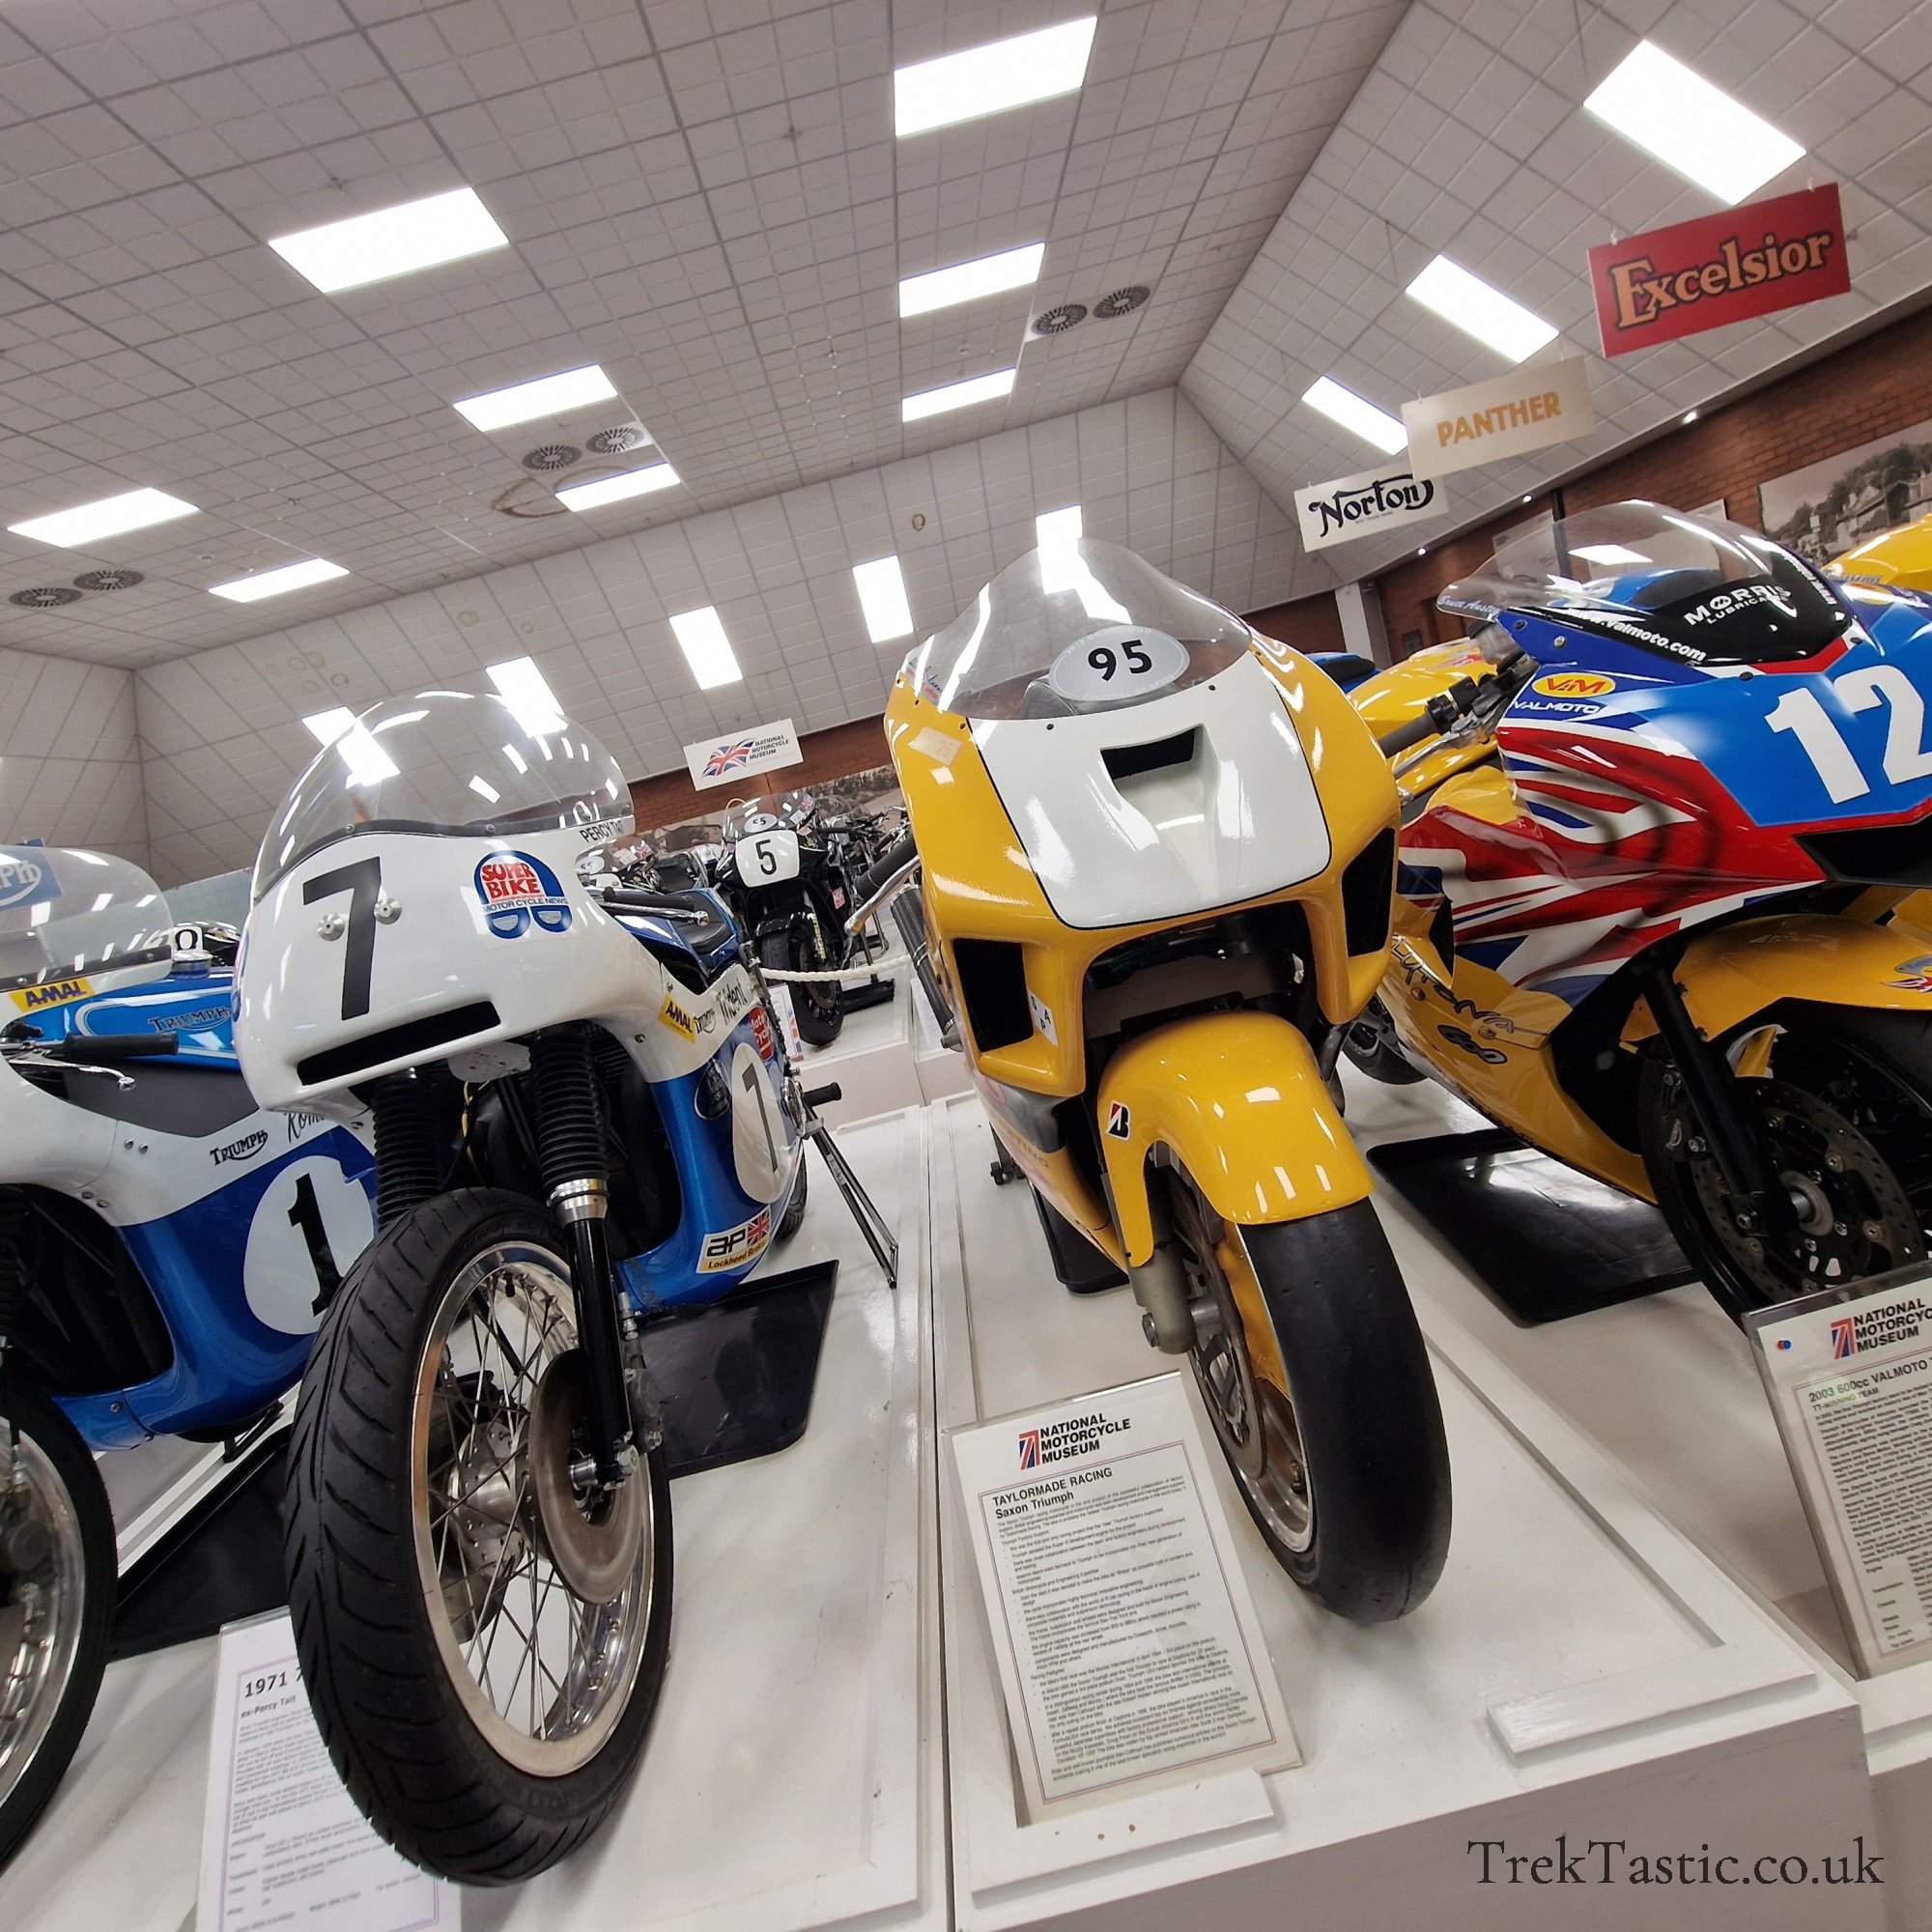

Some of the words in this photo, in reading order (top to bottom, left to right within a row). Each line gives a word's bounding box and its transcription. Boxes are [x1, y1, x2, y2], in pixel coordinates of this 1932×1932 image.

[1610, 232, 1833, 330] Excelsior
[1437, 391, 1562, 448] PANTHER
[1308, 473, 1435, 537] Norton
[1088, 639, 1152, 682] 95
[1514, 700, 1602, 714] VALMOTO
[752, 739, 790, 753] MOTORCYCLE
[754, 734, 785, 747] NATIONAL
[1764, 665, 1932, 805] 12
[749, 749, 777, 760] MUSEUM
[580, 822, 613, 843] PERCY
[755, 838, 777, 875] 5
[481, 863, 535, 882] SUPER
[486, 879, 540, 899] BIKE
[516, 898, 544, 907] CYCLE
[302, 856, 382, 1020] 7
[24, 980, 88, 1008] AMAL
[147, 1007, 234, 1033] TRIUMPH
[665, 1000, 693, 1034] AMAL
[742, 1063, 778, 1173] 1
[210, 1129, 269, 1166] TRIUMPH
[287, 1173, 345, 1317] 1
[707, 1252, 747, 1268] Lockheed
[1854, 1298, 1925, 1326] NATIONAL
[1855, 1308, 1932, 1340] MOTORCYC
[1857, 1325, 1919, 1352] MUSEUM
[1808, 1387, 1834, 1403] 2003
[1836, 1378, 1869, 1394] 600cc
[1870, 1359, 1928, 1383] VALMOTO
[1859, 1387, 1879, 1399] TEAM
[1040, 1413, 1107, 1438] NATIONAL
[1041, 1418, 1131, 1451] MOTORCYCLE
[1042, 1439, 1100, 1464] MUSEUM
[993, 1479, 1067, 1507] TAYLORMADE
[1069, 1467, 1113, 1487] RACING
[995, 1502, 1029, 1520] Saxon
[1031, 1491, 1074, 1512] Triumph
[244, 1671, 288, 1698] 1971
[241, 1702, 277, 1719] ex-Percy
